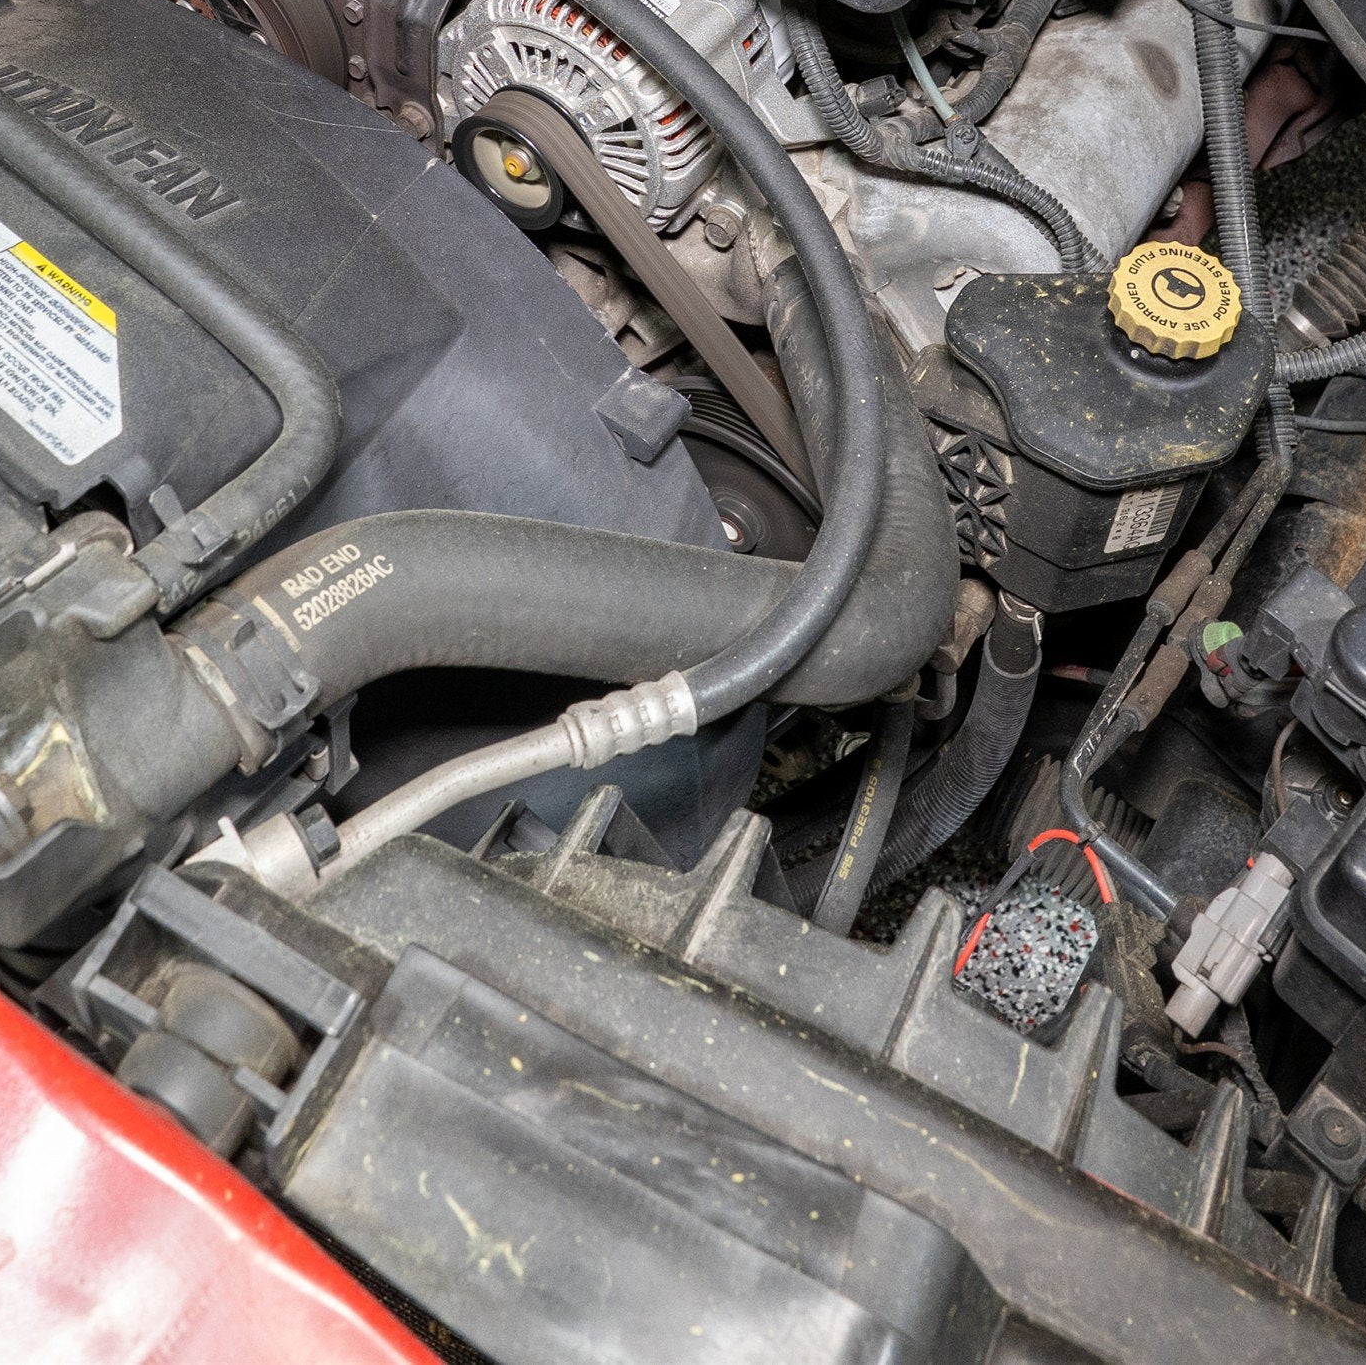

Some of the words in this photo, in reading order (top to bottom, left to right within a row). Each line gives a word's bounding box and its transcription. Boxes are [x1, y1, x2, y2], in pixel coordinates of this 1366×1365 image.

[107, 137, 241, 221] FAN
[1128, 250, 1156, 275] FLUID
[1159, 248, 1223, 278] STEERING
[10, 282, 25, 292] TO
[29, 298, 66, 325] SERVICED
[62, 324, 76, 333] BY
[44, 270, 94, 306] WARNING
[1126, 282, 1178, 329] APPROVED
[1213, 281, 1231, 320] POWER
[1184, 319, 1210, 331] USE
[0, 351, 31, 375] OCCUR
[25, 373, 51, 393] FROM
[1, 367, 39, 397] IGNITION
[280, 566, 325, 599] RAD
[319, 544, 361, 575] END
[293, 555, 394, 631] 52028826AC
